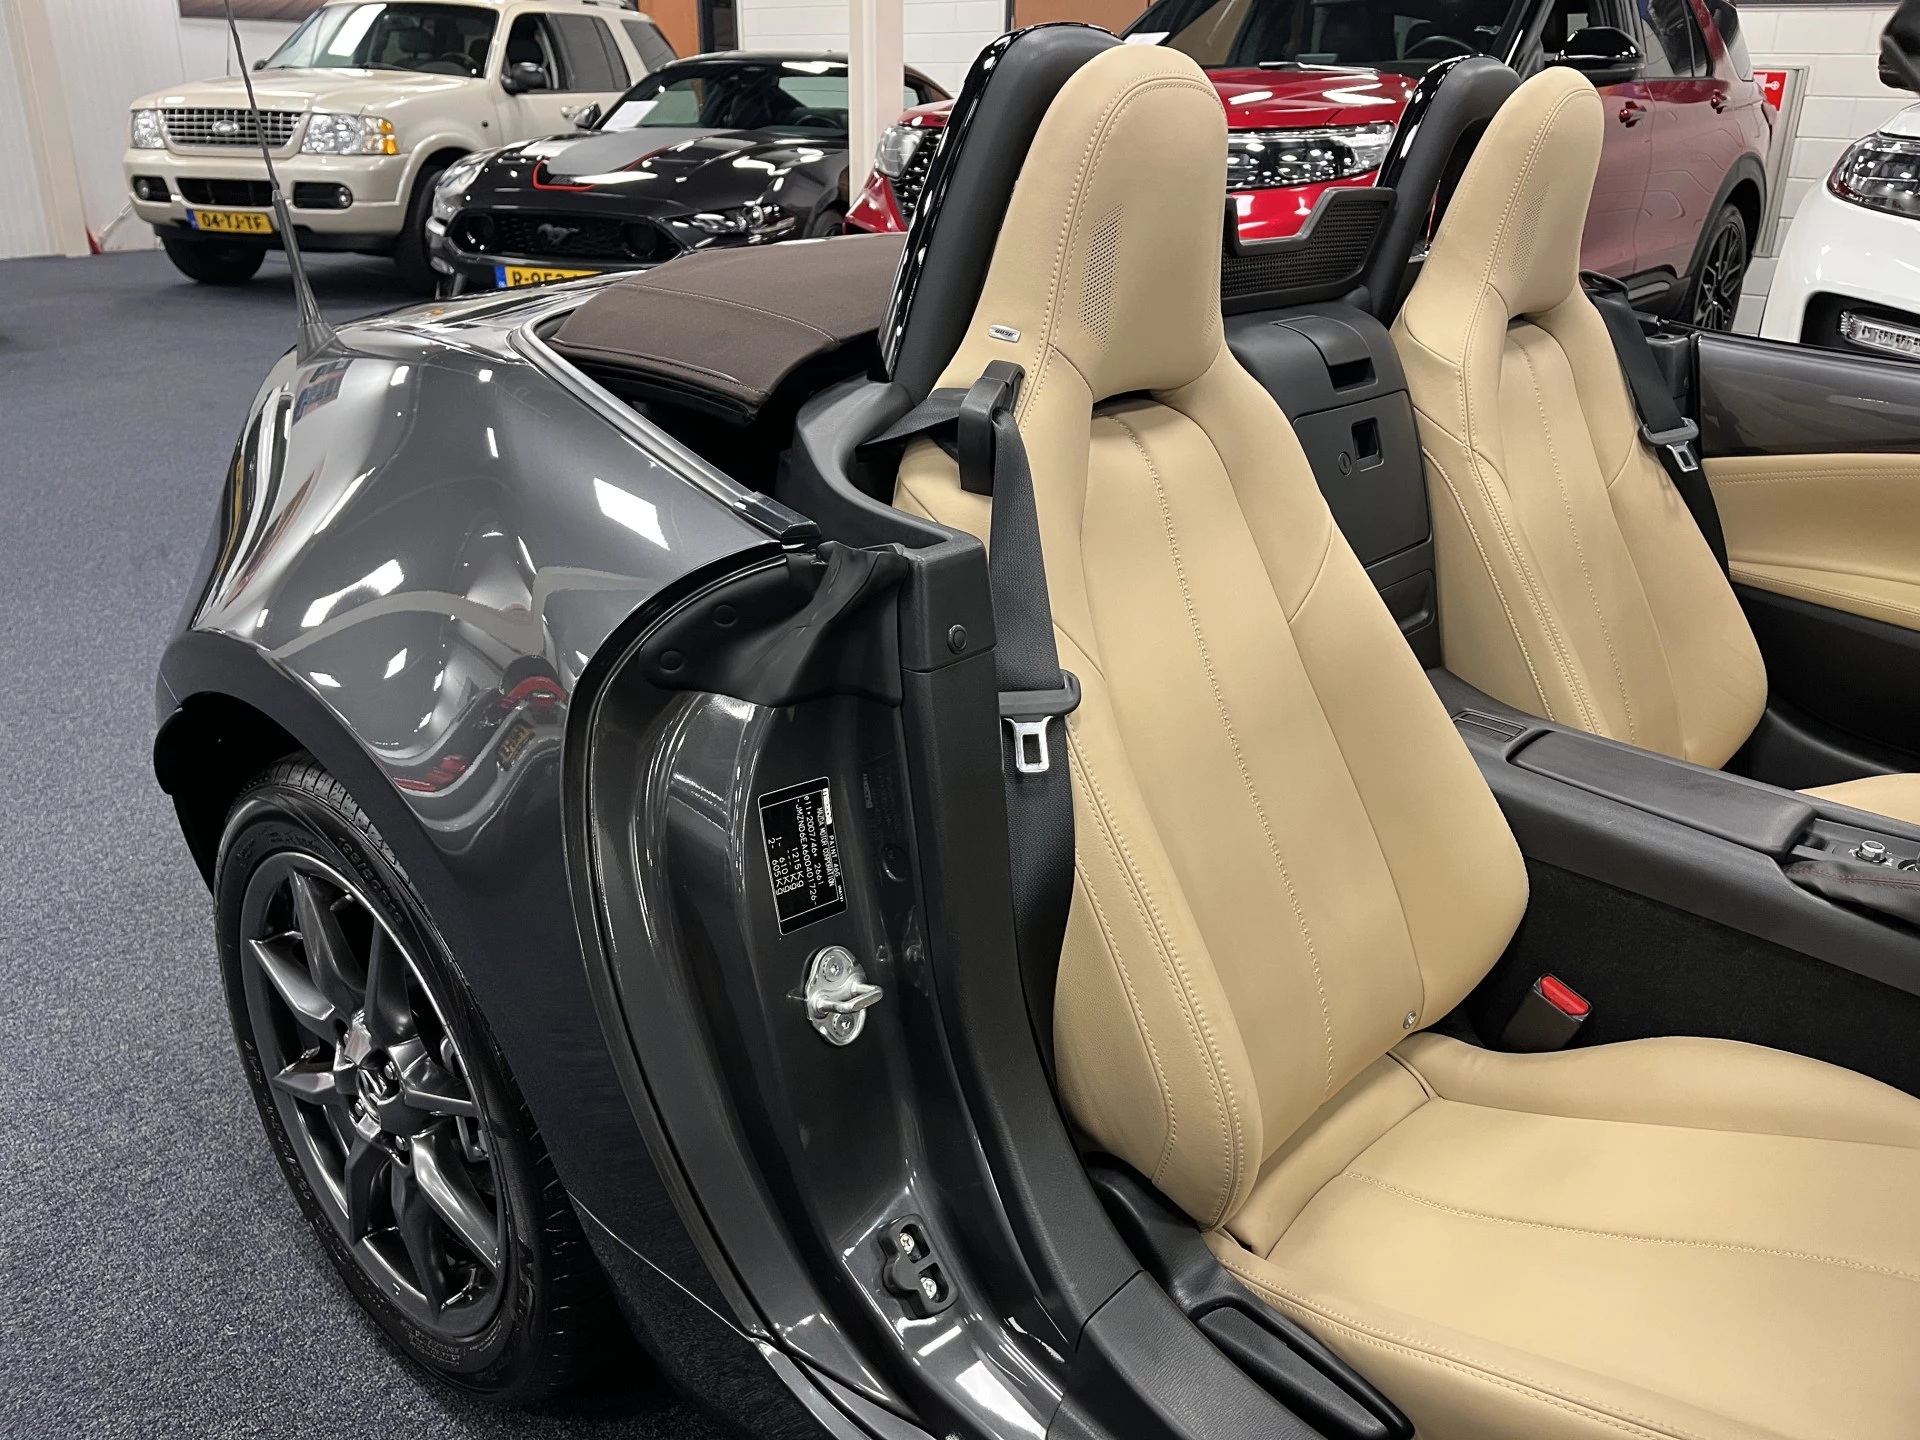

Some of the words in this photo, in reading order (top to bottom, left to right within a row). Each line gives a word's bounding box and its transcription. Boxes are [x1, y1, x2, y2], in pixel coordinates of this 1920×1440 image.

[816, 807, 825, 826] MAZDA
[819, 827, 828, 846] MOTOR
[813, 863, 824, 886] 2661
[822, 847, 835, 887] CORPORATION
